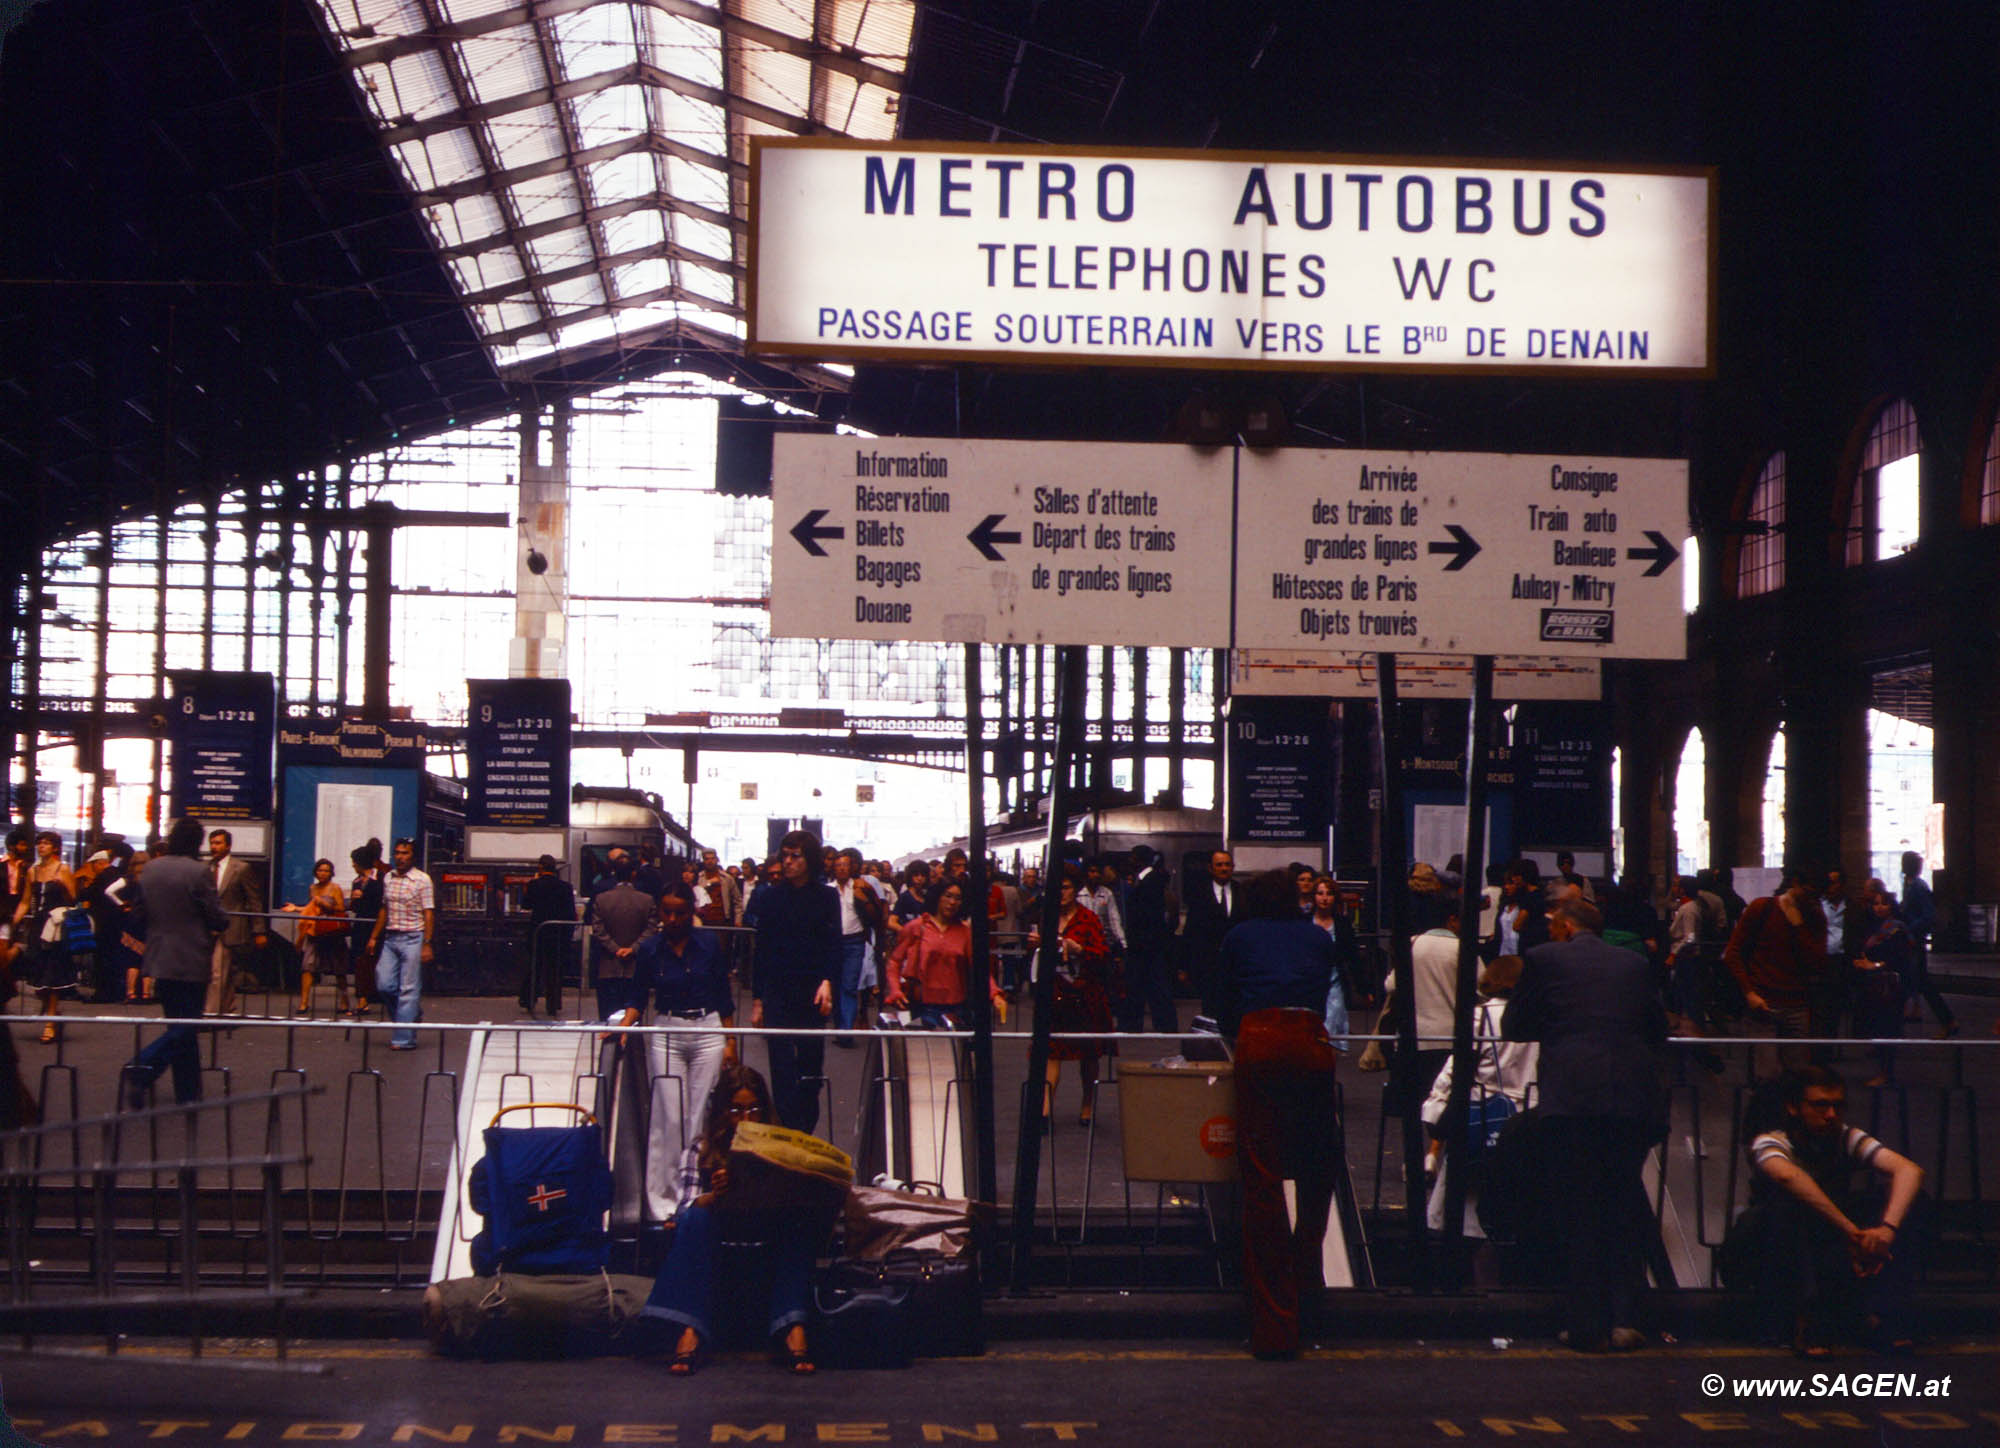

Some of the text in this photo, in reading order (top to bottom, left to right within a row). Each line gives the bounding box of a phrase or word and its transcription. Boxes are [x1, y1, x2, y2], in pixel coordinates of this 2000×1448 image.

[864, 156, 1607, 238] METRO AUTOBUS
[977, 243, 1326, 299] TELEPHONES
[818, 307, 972, 342] PASSAGE
[994, 313, 1213, 348] SOUTERRAIN
[1236, 317, 1324, 354] VERS
[1346, 324, 1381, 355] LE
[1466, 327, 1506, 357] DE
[1528, 328, 1650, 361] DENAIN
[856, 450, 948, 478] Information
[1358, 465, 1418, 492] Arrivée
[1550, 465, 1618, 498] Consigne
[856, 485, 950, 513] Réservation
[1034, 487, 1158, 516] Salles d'attente
[1312, 498, 1418, 526] des trains de
[1528, 504, 1617, 533] Train auto
[856, 520, 904, 547] Billets
[1033, 521, 1176, 554] Départ des trains
[1304, 534, 1418, 567] grandes lignes
[1553, 539, 1616, 567] Banlieue
[856, 555, 921, 588] Bagages
[1032, 563, 1173, 598] de grandes lignes
[1272, 573, 1417, 601] Hôtesses de Paris
[856, 596, 912, 623] Douane
[1300, 608, 1417, 641] Objets trouvés
[182, 696, 194, 715] 8
[480, 704, 493, 723] 9
[1237, 721, 1256, 740] 10
